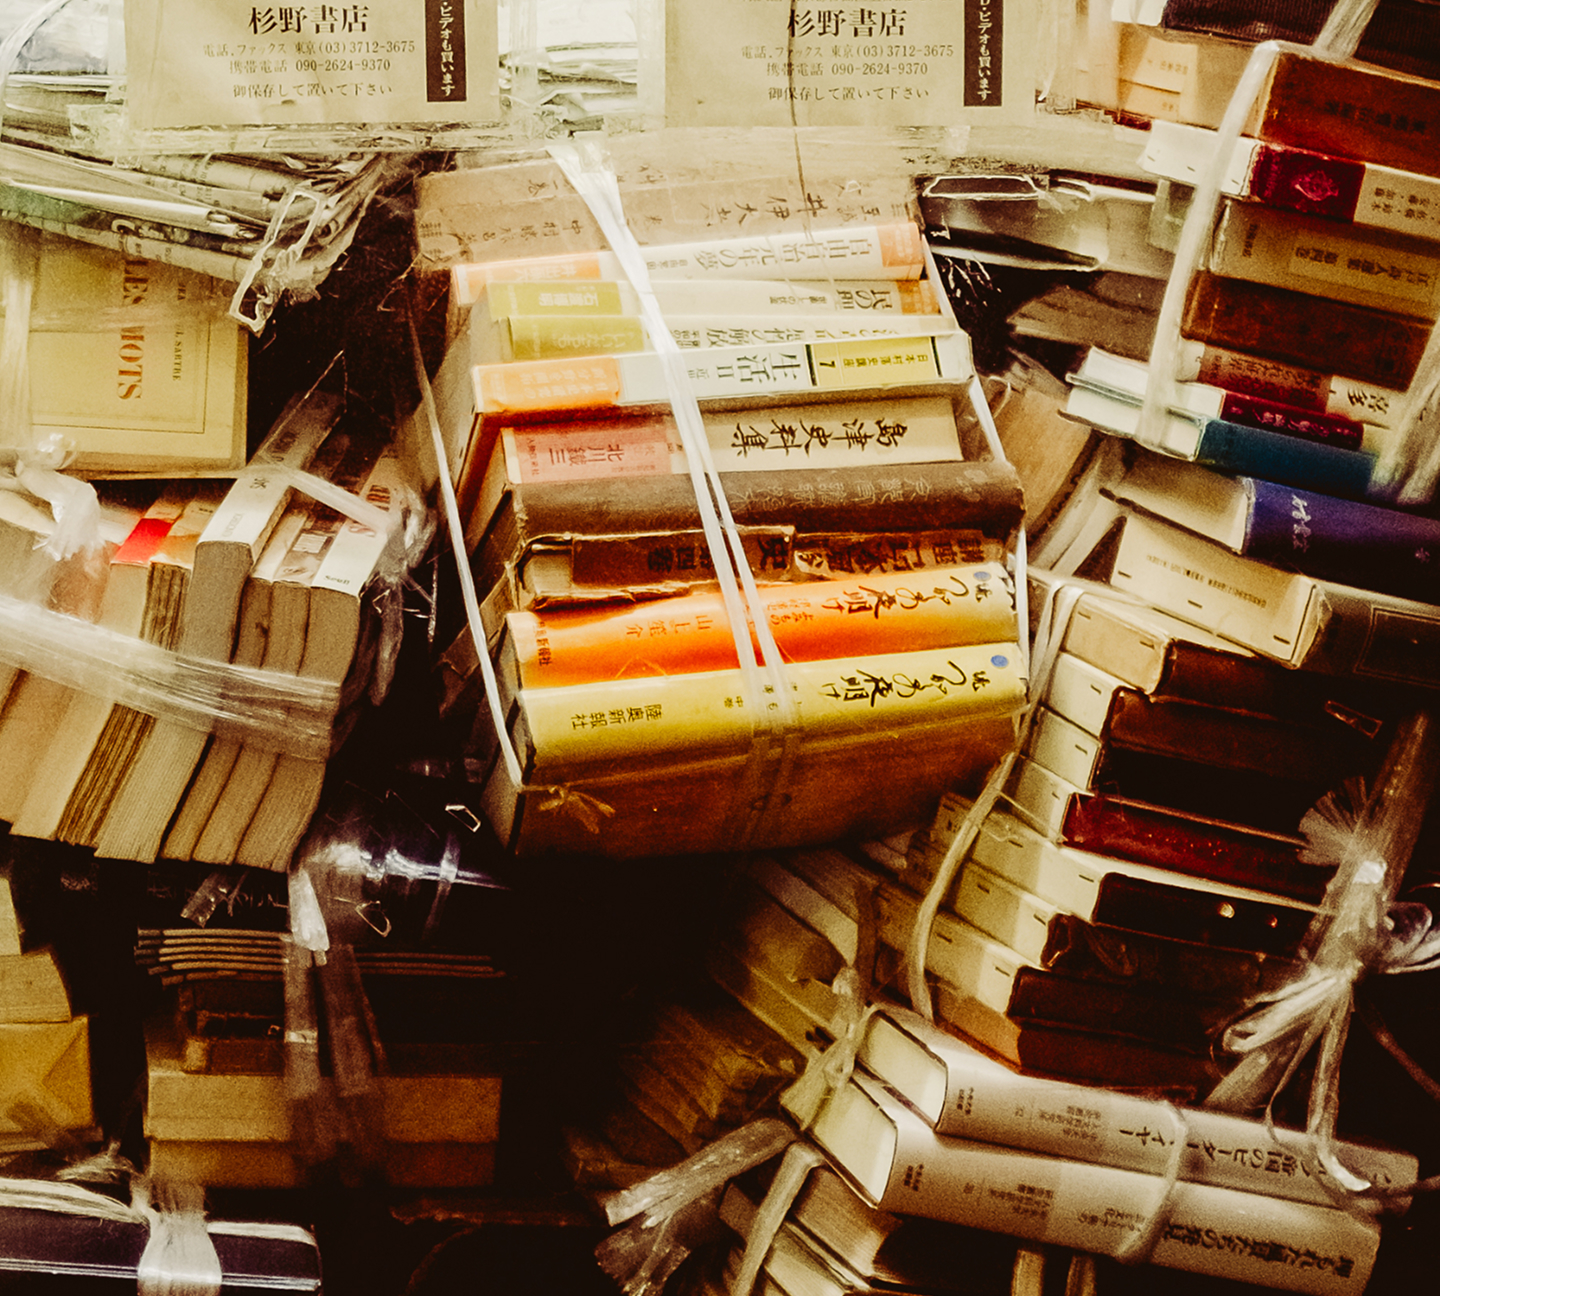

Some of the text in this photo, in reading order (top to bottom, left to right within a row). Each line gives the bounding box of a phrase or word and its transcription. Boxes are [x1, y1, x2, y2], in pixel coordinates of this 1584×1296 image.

[248, 5, 368, 35] 杉野書店
[787, 8, 907, 38] 杉野書店
[229, 59, 391, 74] 携帯電話 090-2624-9370
[767, 62, 928, 77] 携帯電話 090-2624-9370
[233, 83, 392, 98] 御保存して置いて下さい
[768, 87, 929, 101] 御保存して置いて下さい
[695, 236, 876, 272] 自由自治元年の夢
[819, 357, 837, 368] 7
[731, 418, 908, 457] 島津史料集
[569, 702, 664, 732] 陸奥新報社
